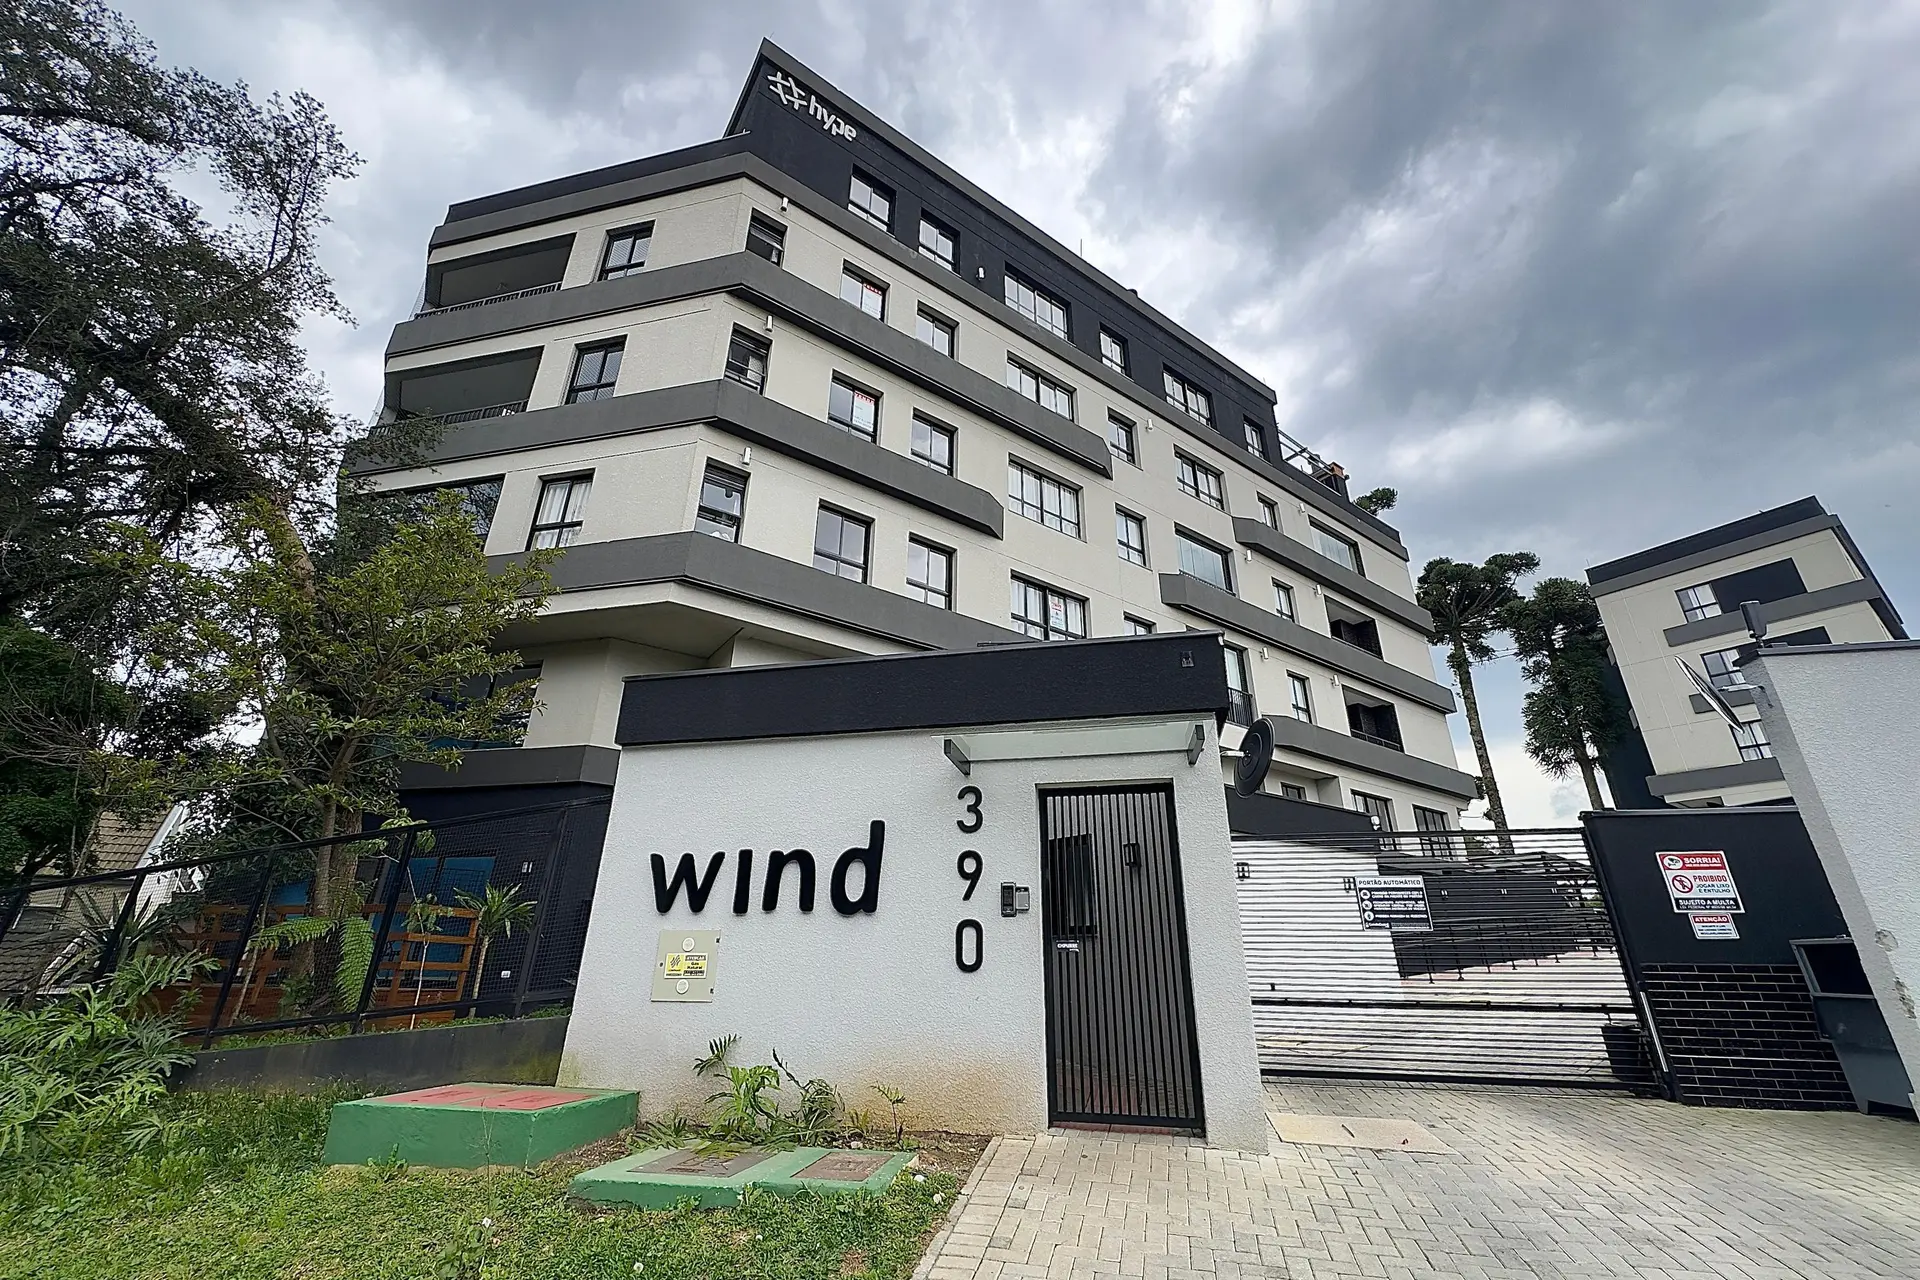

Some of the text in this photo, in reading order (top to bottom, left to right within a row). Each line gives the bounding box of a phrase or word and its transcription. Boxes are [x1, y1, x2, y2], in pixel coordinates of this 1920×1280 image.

[809, 94, 857, 141] hype
[650, 819, 886, 916] wind
[955, 785, 984, 973] 390
